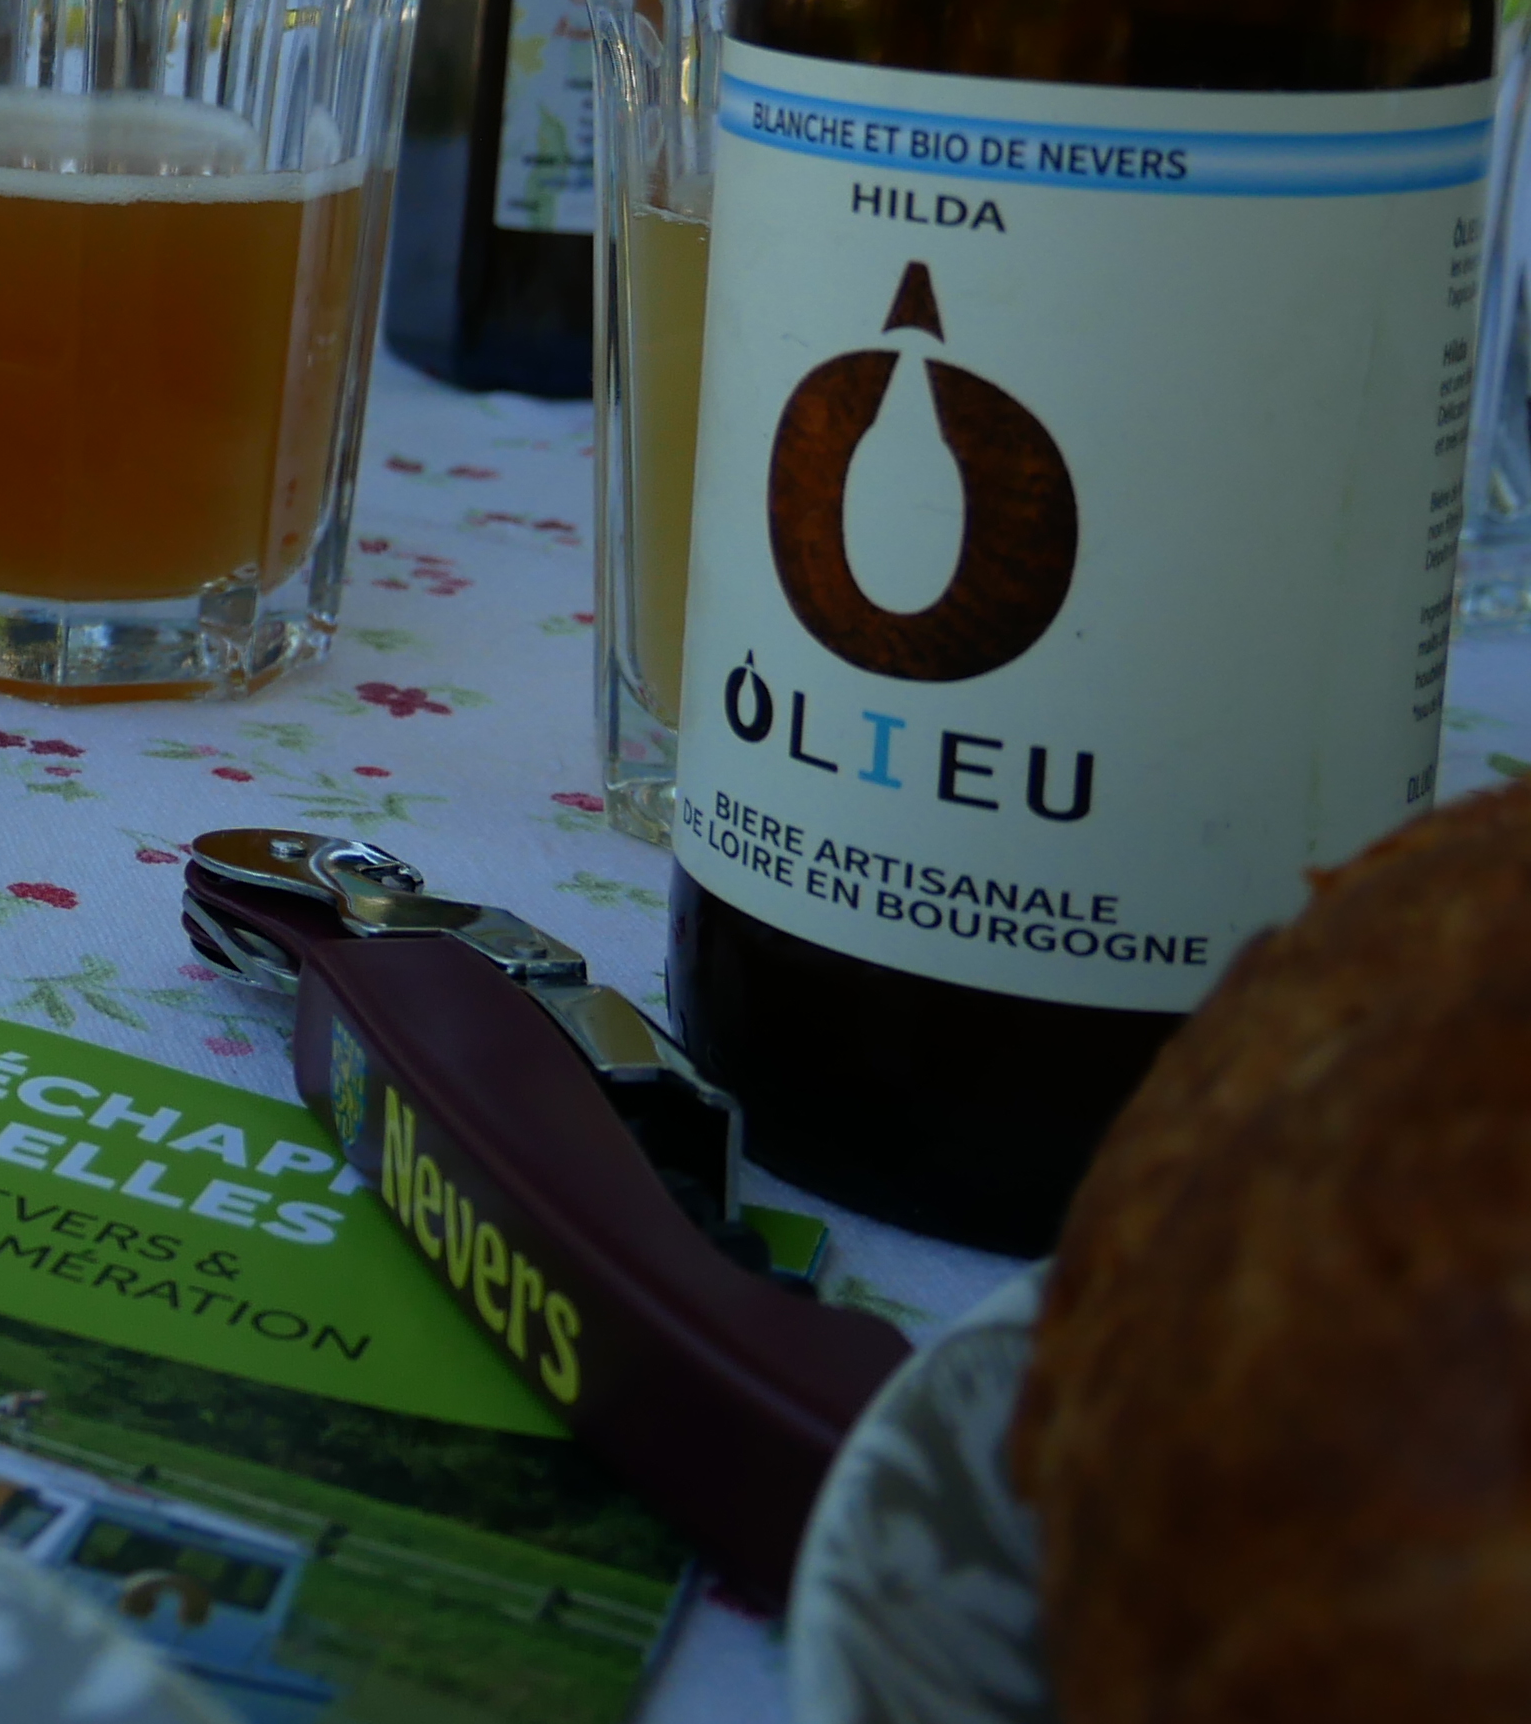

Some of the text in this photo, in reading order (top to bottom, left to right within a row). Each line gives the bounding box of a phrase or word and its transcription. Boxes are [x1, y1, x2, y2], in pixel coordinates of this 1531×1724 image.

[751, 101, 1189, 182] BLANCHE ET BIO DE NEVERS
[850, 182, 1007, 234] HILDA
[682, 797, 1210, 966] DE LOIRE EN BOURGOGNE
[814, 837, 1121, 926] ARTISANALE
[193, 1248, 245, 1281] &
[379, 1084, 583, 1405] Nevers
